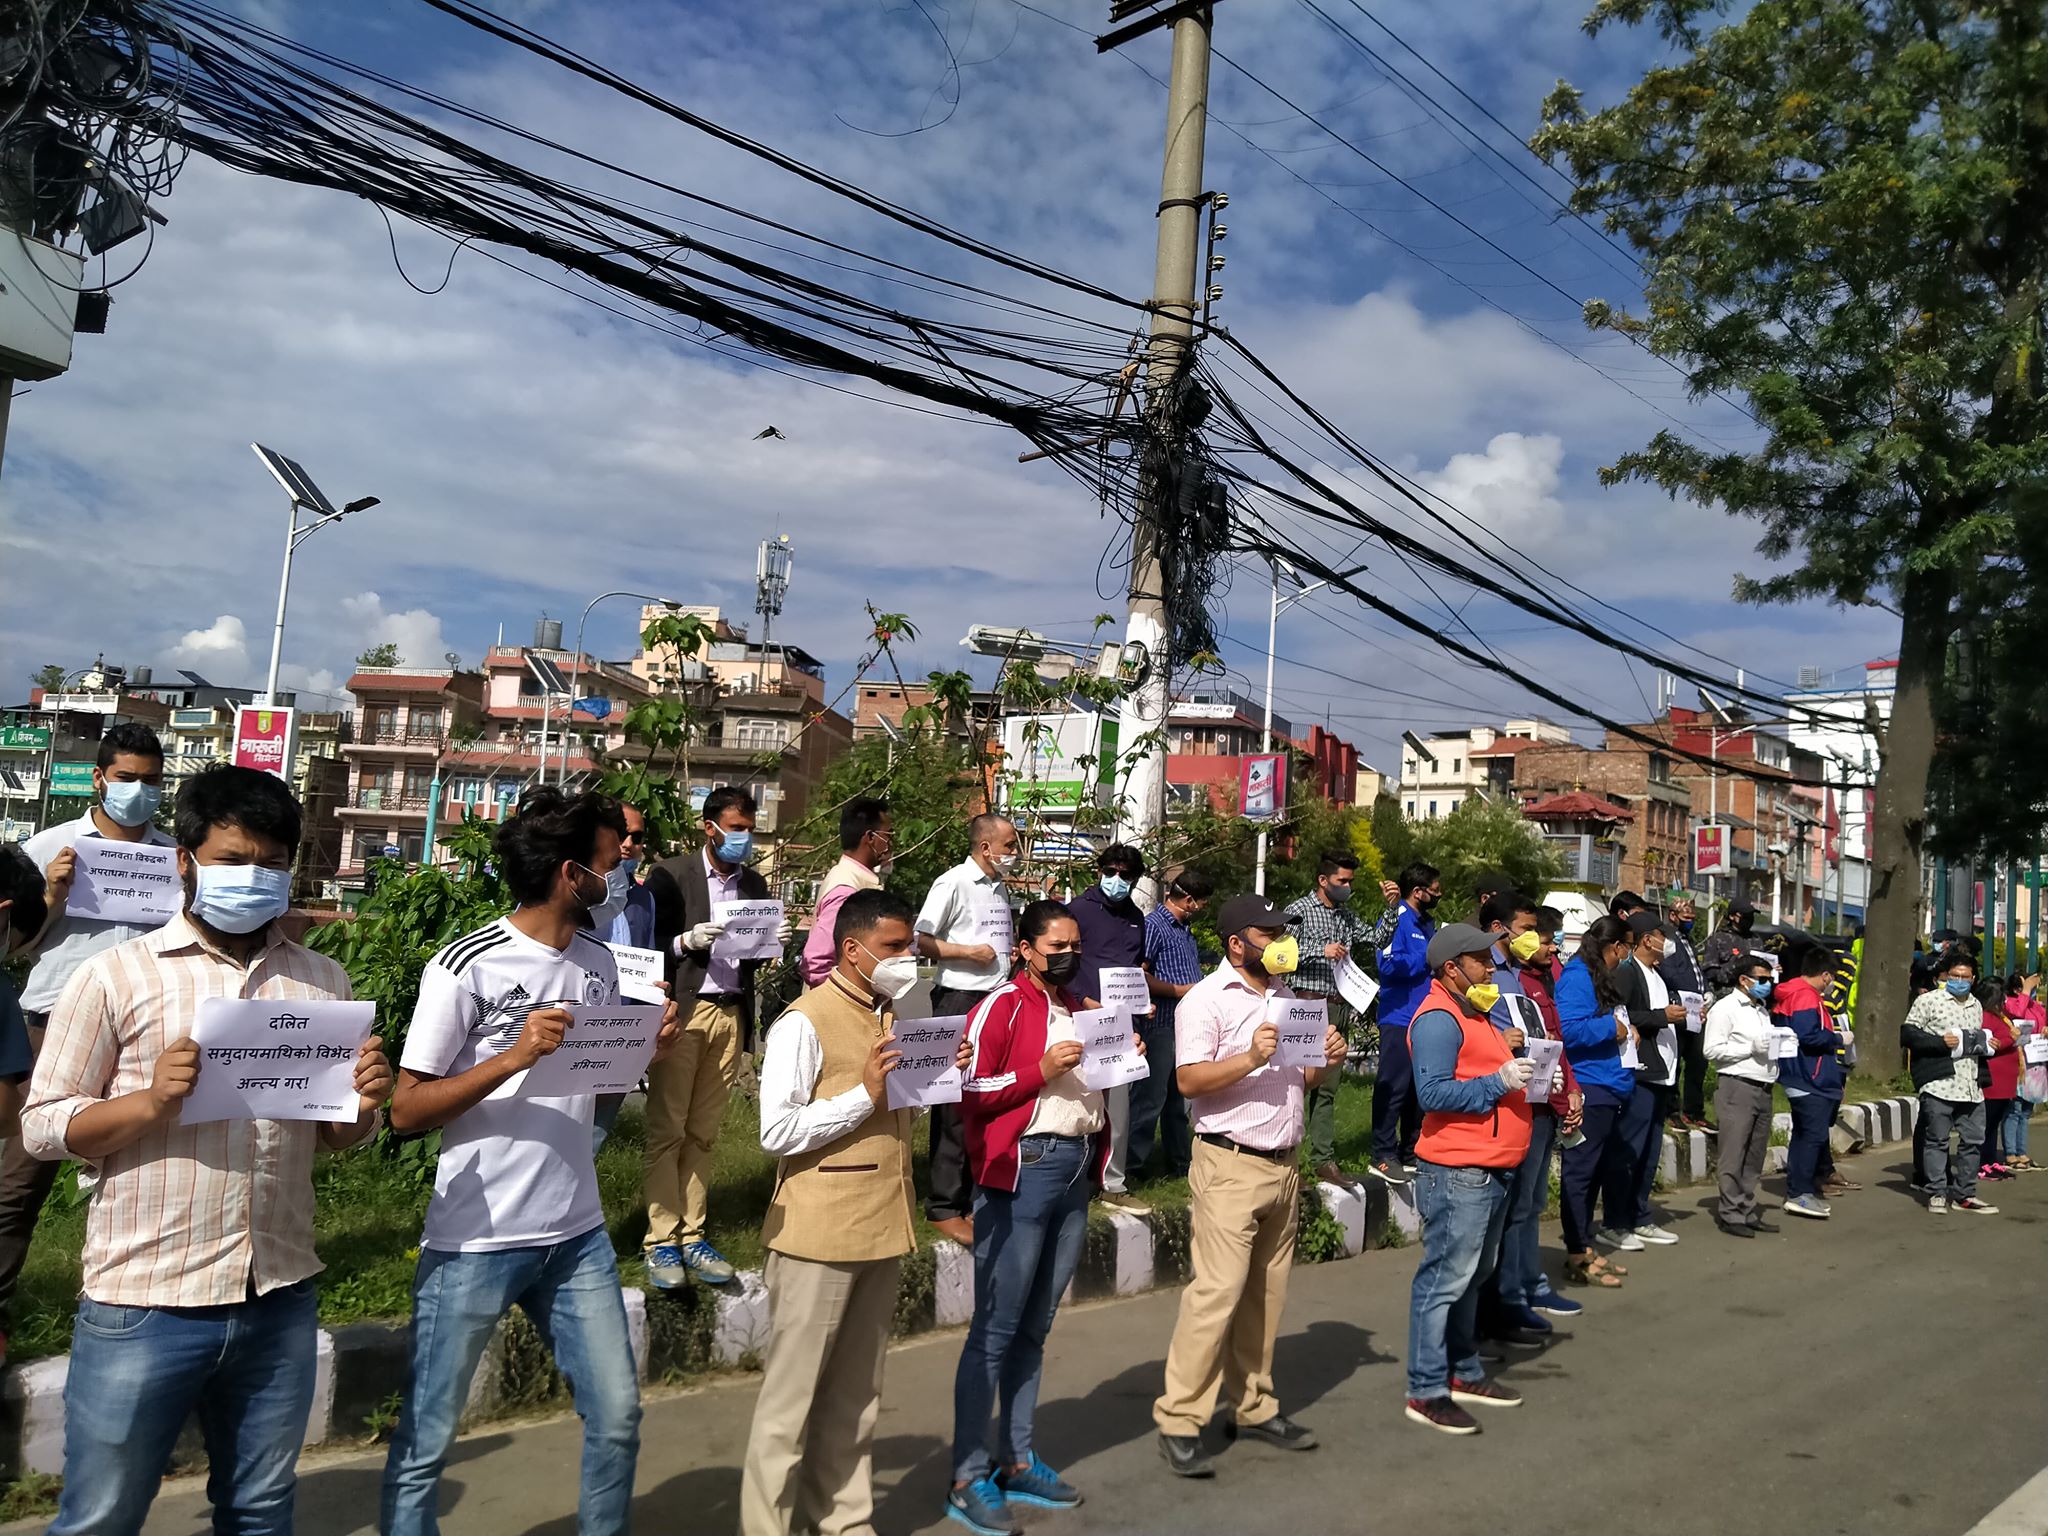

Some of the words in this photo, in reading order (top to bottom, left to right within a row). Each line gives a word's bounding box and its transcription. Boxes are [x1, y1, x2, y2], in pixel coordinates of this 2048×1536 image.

[100, 850, 133, 861] मानवता
[89, 867, 128, 879] अपराधमा
[103, 887, 136, 898] कारवाही
[758, 906, 779, 917] समिति
[735, 927, 754, 935] गठन
[507, 993, 531, 1001] adidas
[269, 1013, 310, 1030] दलित
[634, 1018, 642, 1027] र
[901, 1029, 933, 1043] मर्यादित
[933, 1028, 956, 1040] जीवन
[1282, 1034, 1302, 1043] न्याय
[603, 1037, 627, 1048] लागि
[207, 1045, 313, 1065] समुदायमाथिको
[316, 1045, 354, 1060] विभेद
[236, 1077, 280, 1090] अन्त्य
[284, 1076, 310, 1090] गर!
